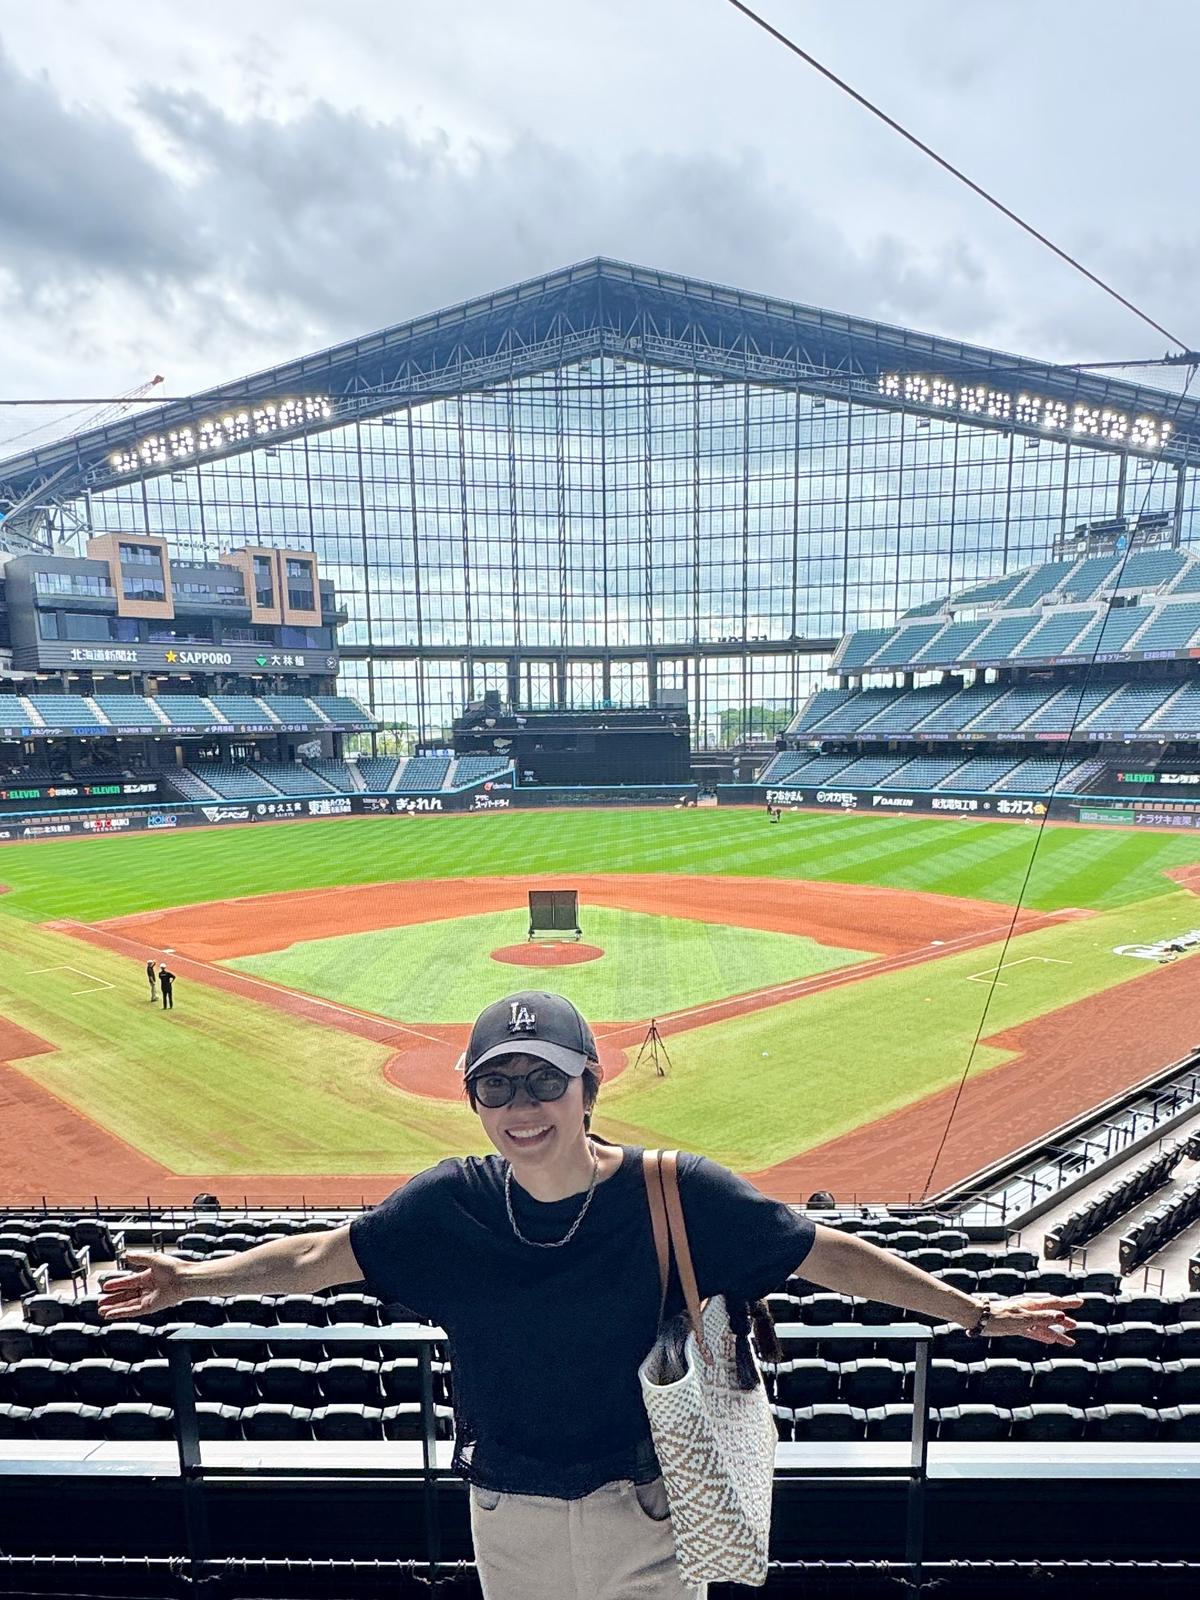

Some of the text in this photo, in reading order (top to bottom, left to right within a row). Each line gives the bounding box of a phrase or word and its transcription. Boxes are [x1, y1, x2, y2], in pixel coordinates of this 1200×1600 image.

[70, 648, 138, 662] 北海道新聞社
[178, 651, 232, 665] SAPPORO
[271, 655, 305, 667] 大林組
[71, 727, 108, 736] TOPPAN
[395, 797, 443, 811] ぎょれん
[474, 799, 510, 809] スーパードライ
[825, 792, 858, 803] オカモト
[880, 798, 914, 807] DAIKIN
[996, 799, 1034, 815] 北ガス
[508, 1001, 536, 1032] LA
